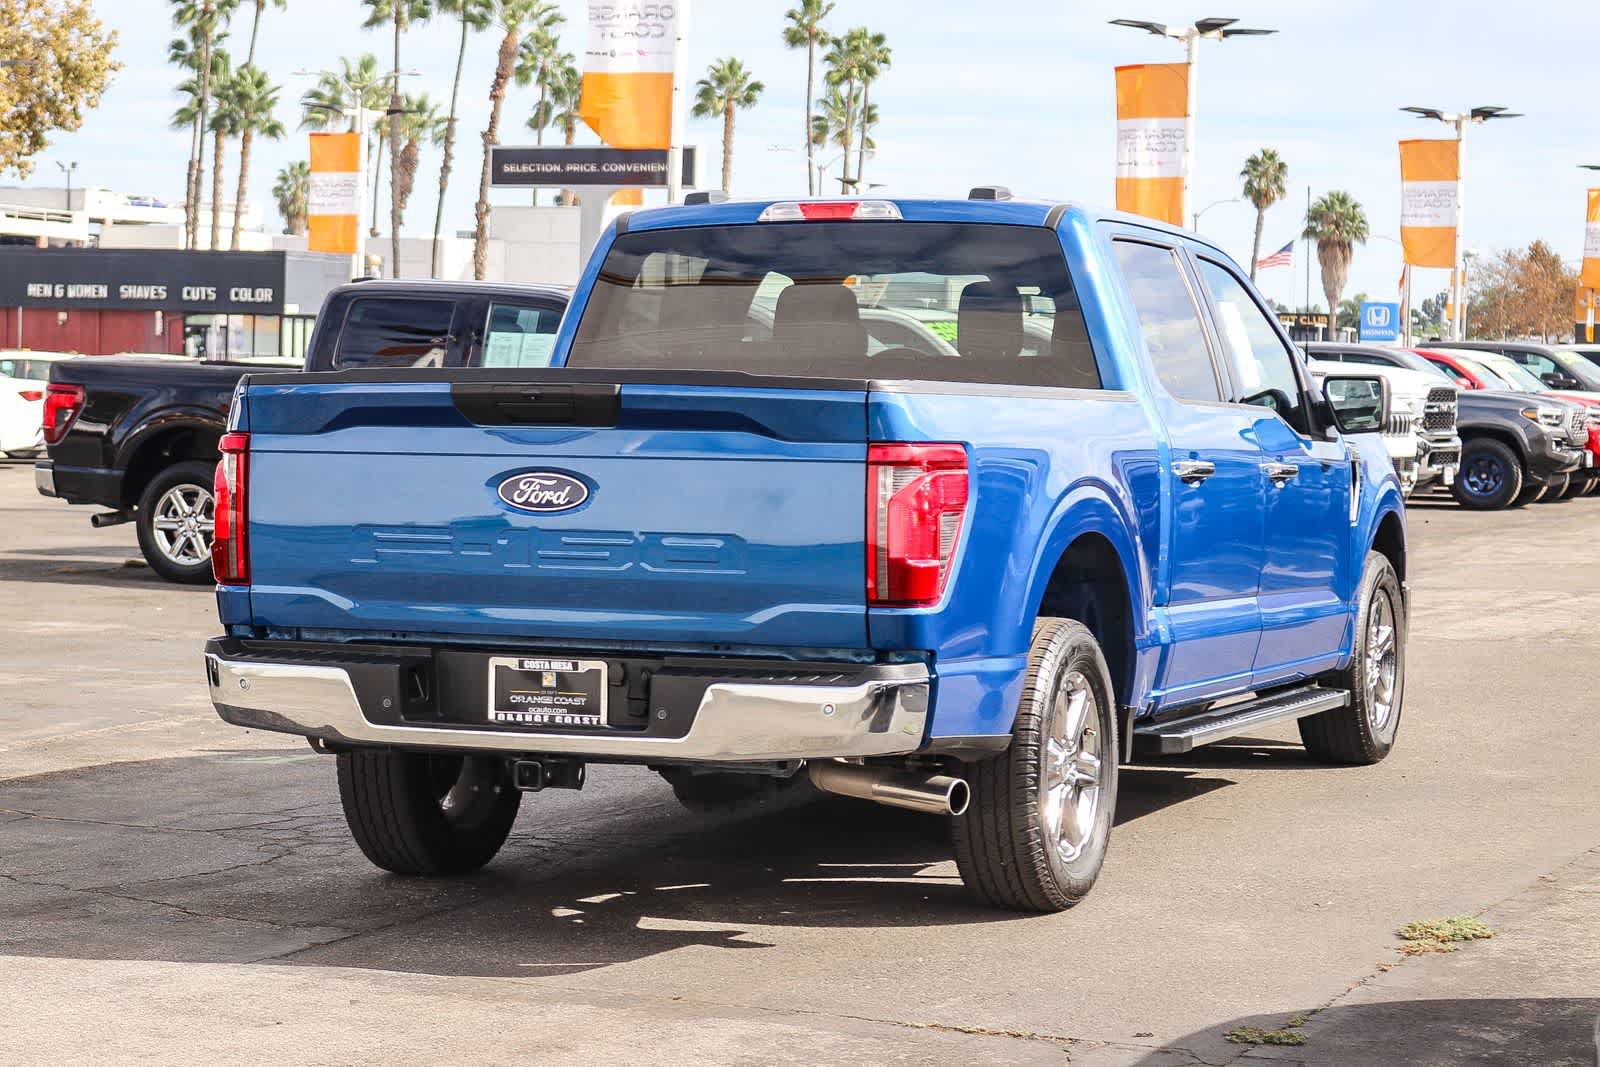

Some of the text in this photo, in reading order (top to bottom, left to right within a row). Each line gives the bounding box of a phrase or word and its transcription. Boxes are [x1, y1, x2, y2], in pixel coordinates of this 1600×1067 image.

[503, 163, 564, 173] SELECTION.
[566, 163, 600, 173] PRICE.
[27, 283, 52, 298] MEN
[67, 284, 108, 299] WOMEN
[119, 285, 167, 300] SHAVES
[182, 286, 216, 301] CUTS
[229, 287, 273, 302] COLOR
[1362, 328, 1394, 337] HONDA
[512, 477, 571, 506] Ford
[349, 522, 749, 575] F-150
[523, 660, 573, 670] COSTA MESA
[509, 695, 587, 705] ORANGE COAST
[497, 713, 599, 724] ORANGE COAST
